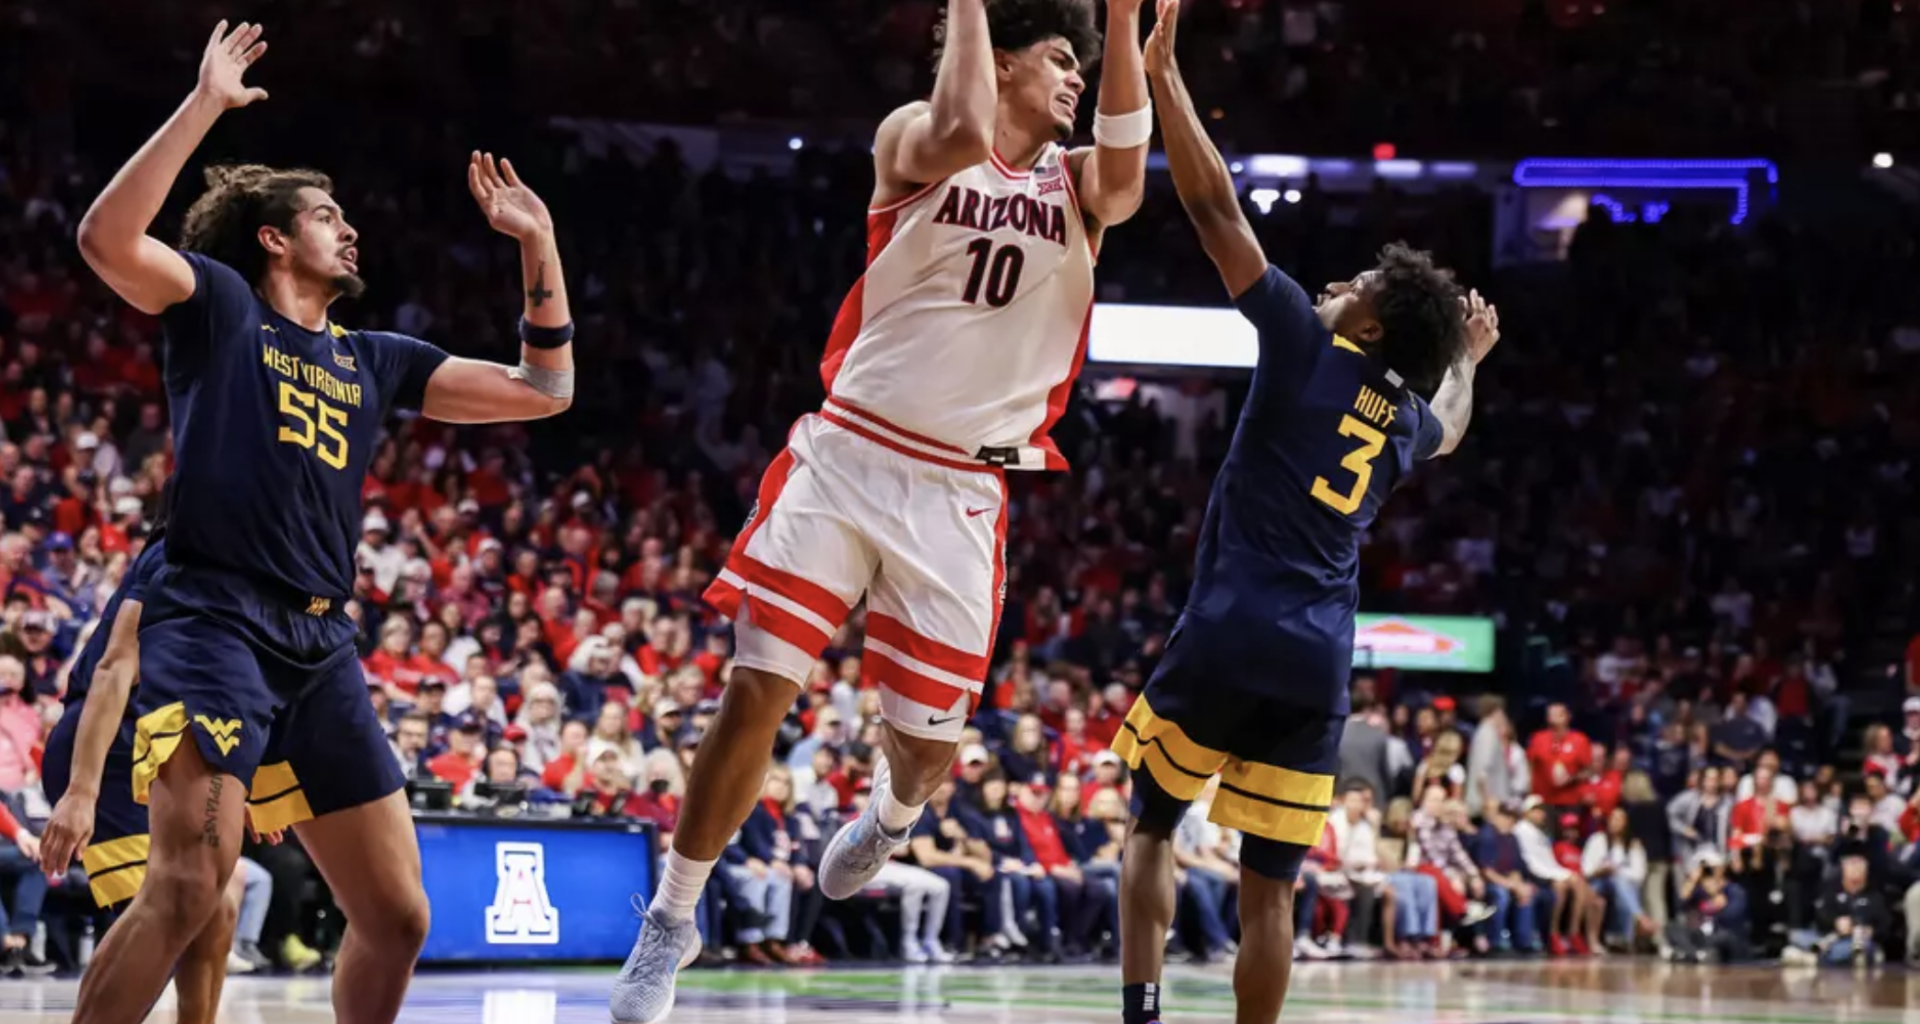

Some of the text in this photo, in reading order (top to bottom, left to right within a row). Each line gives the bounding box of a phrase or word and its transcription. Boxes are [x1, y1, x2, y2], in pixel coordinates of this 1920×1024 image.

[932, 185, 1066, 247] ARIZONA
[961, 236, 1025, 308] 10
[263, 344, 362, 409] WEST VIRGINIA
[1354, 384, 1398, 428] HUFF
[278, 381, 349, 470] 55
[1310, 413, 1387, 515] 3
[485, 841, 559, 944] A
